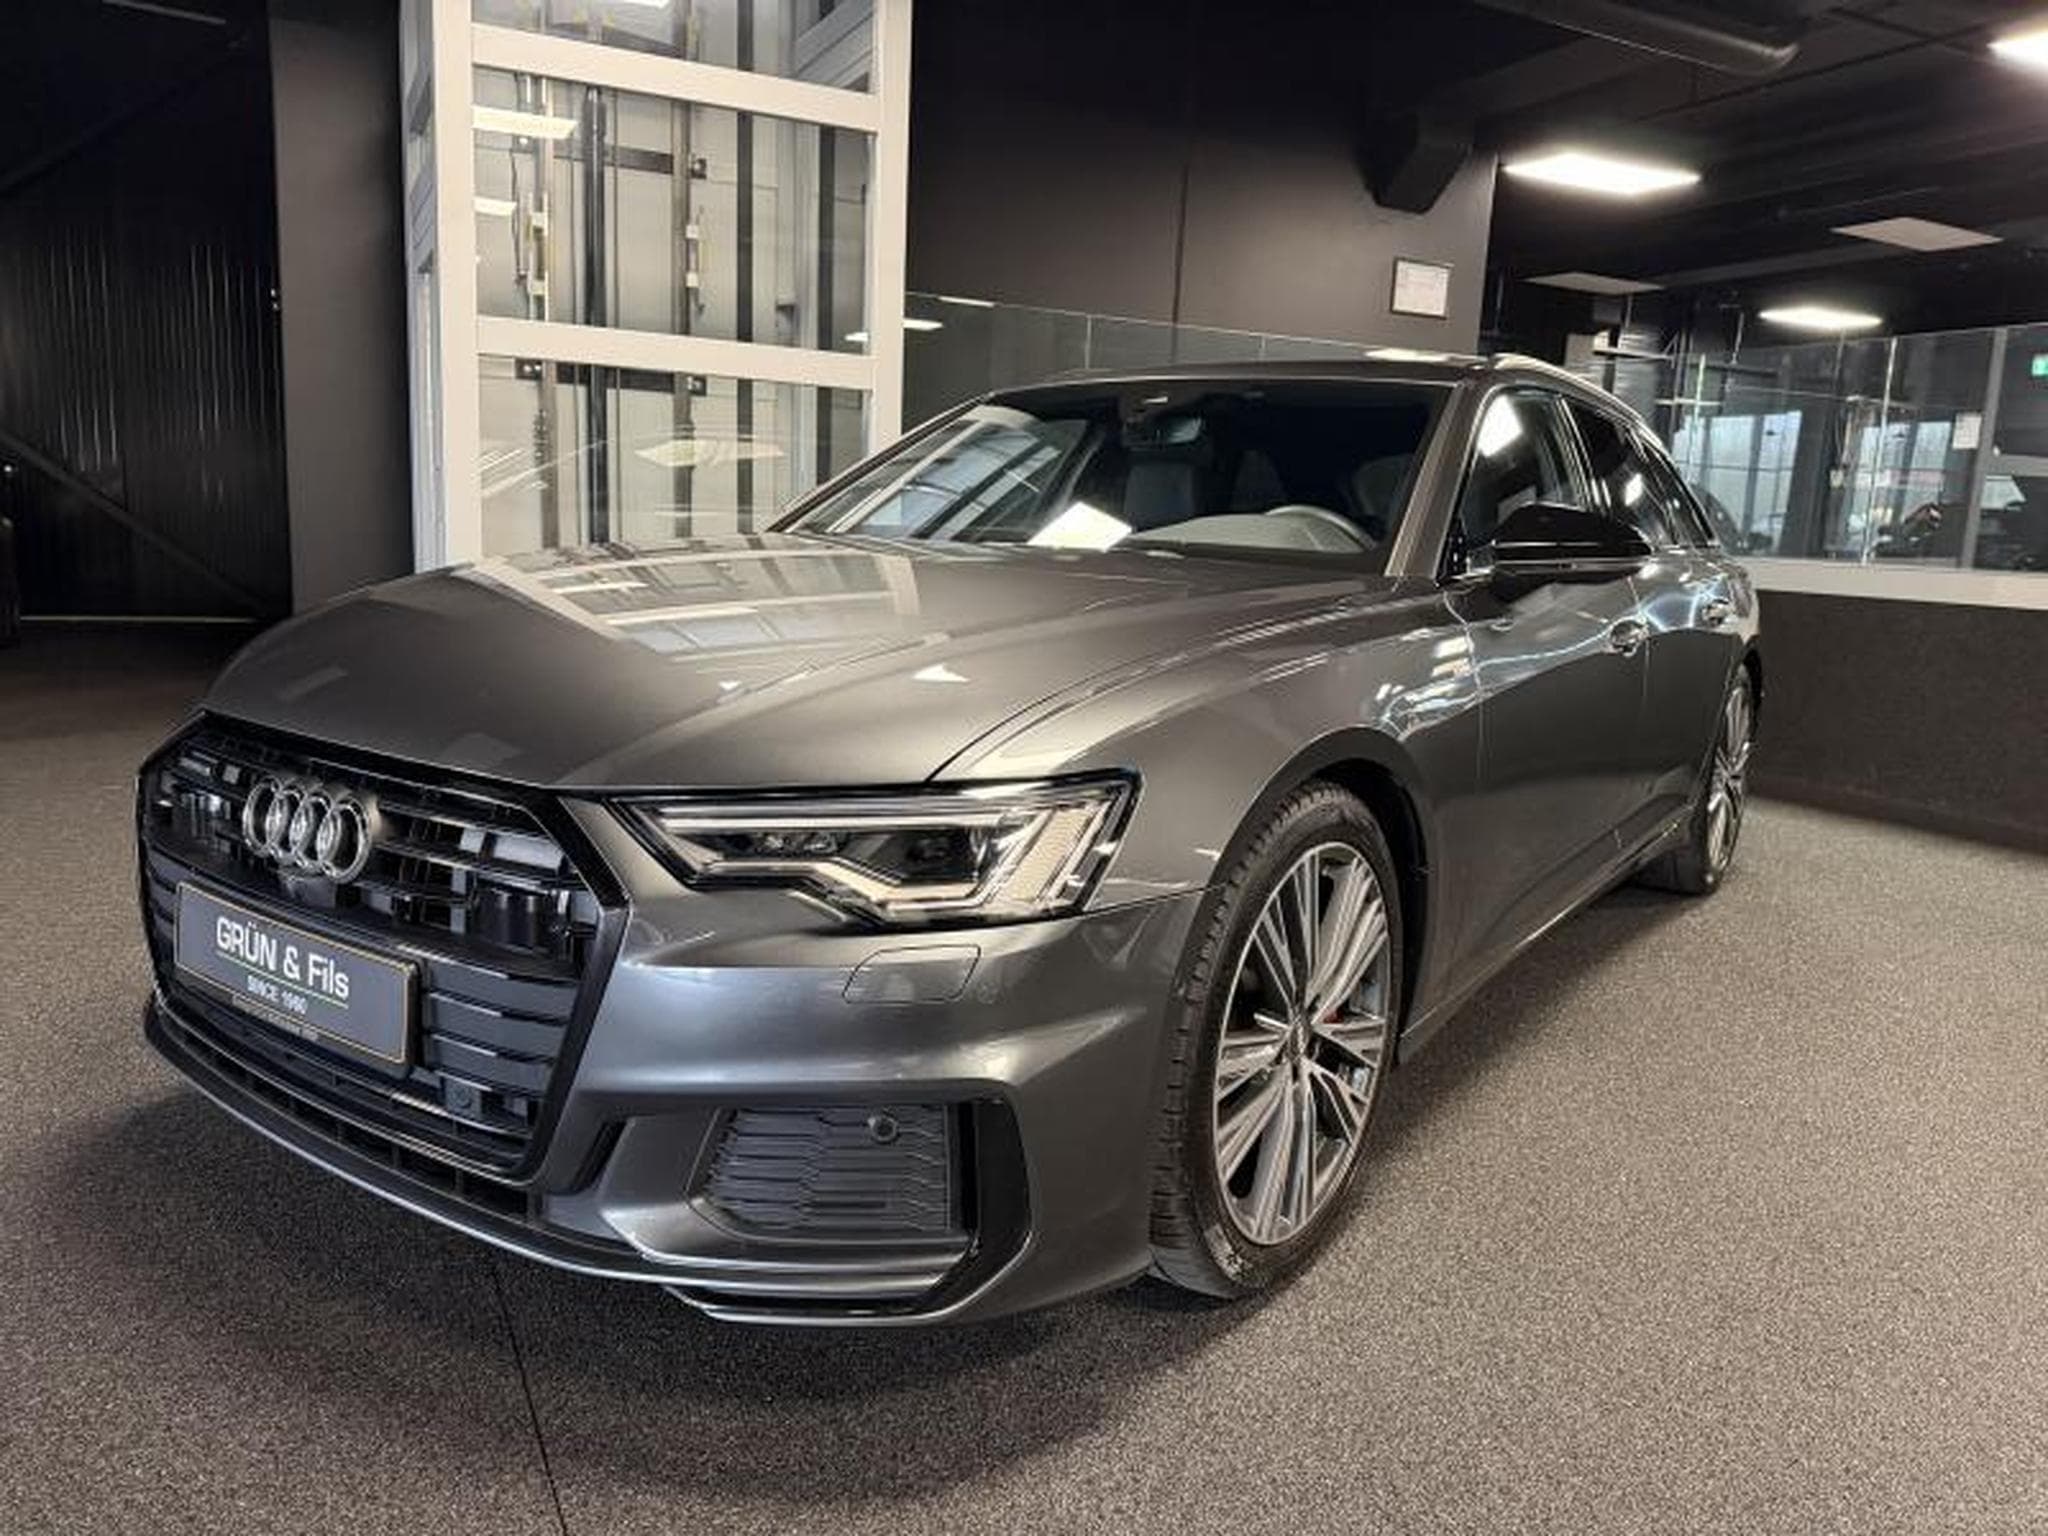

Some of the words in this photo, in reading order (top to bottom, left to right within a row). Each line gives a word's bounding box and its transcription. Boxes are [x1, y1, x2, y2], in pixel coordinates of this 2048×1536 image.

[216, 916, 276, 972] GRÜN
[283, 945, 300, 981] &
[308, 953, 350, 1000] Fils
